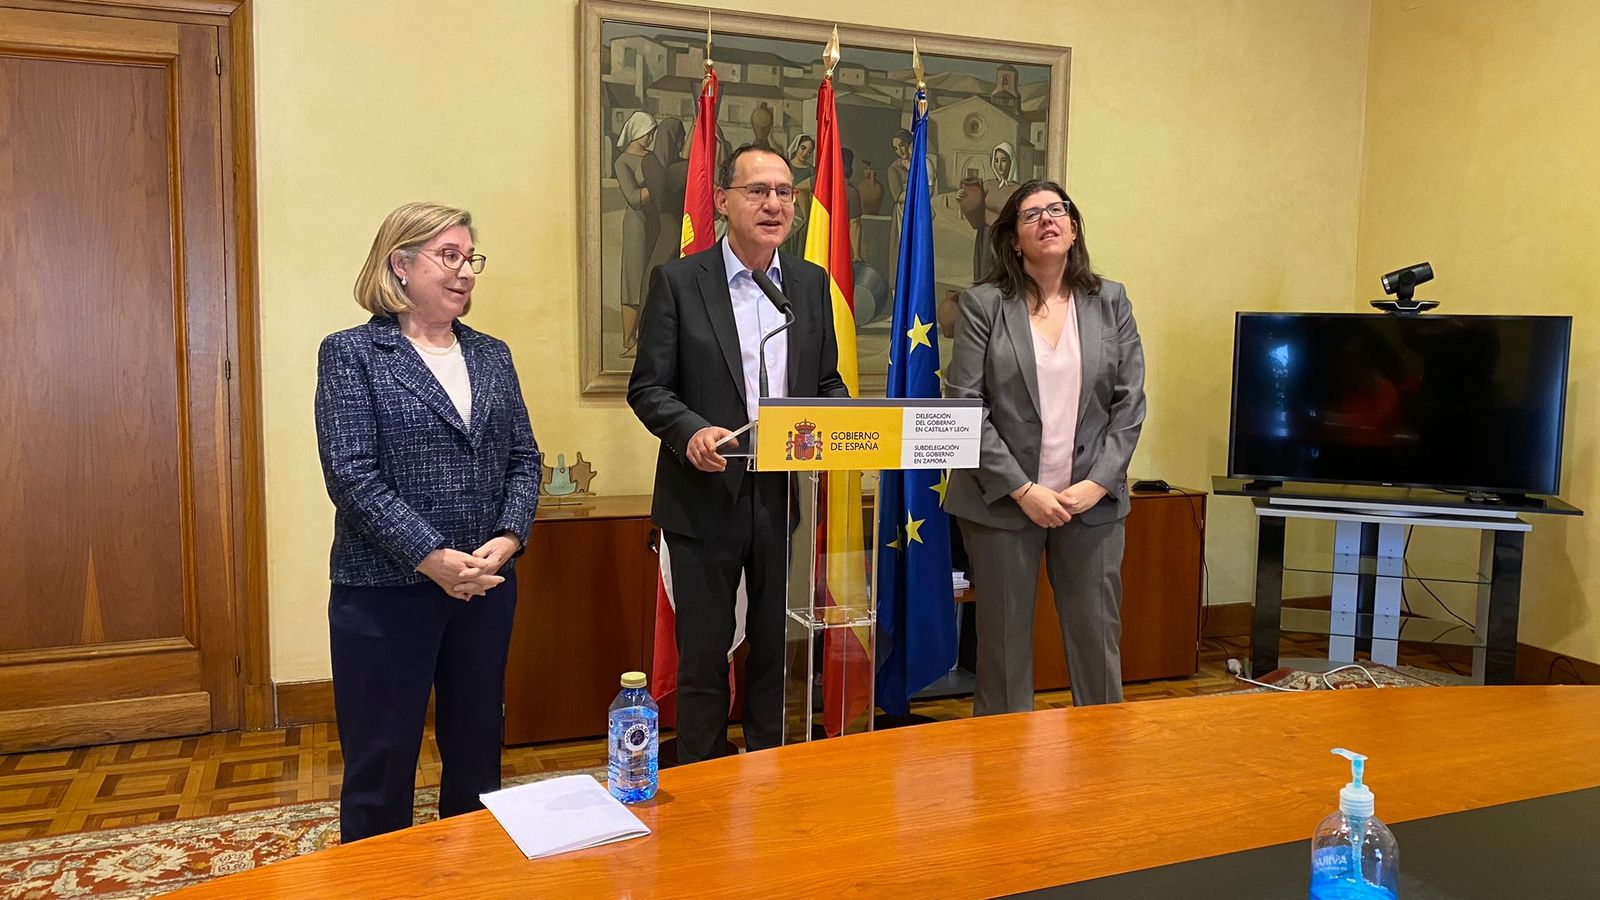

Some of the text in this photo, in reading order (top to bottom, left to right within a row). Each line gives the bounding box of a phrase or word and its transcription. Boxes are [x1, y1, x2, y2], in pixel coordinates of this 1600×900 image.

[831, 431, 880, 440] GOBIERNO
[830, 440, 879, 451] DE ESPAÑA
